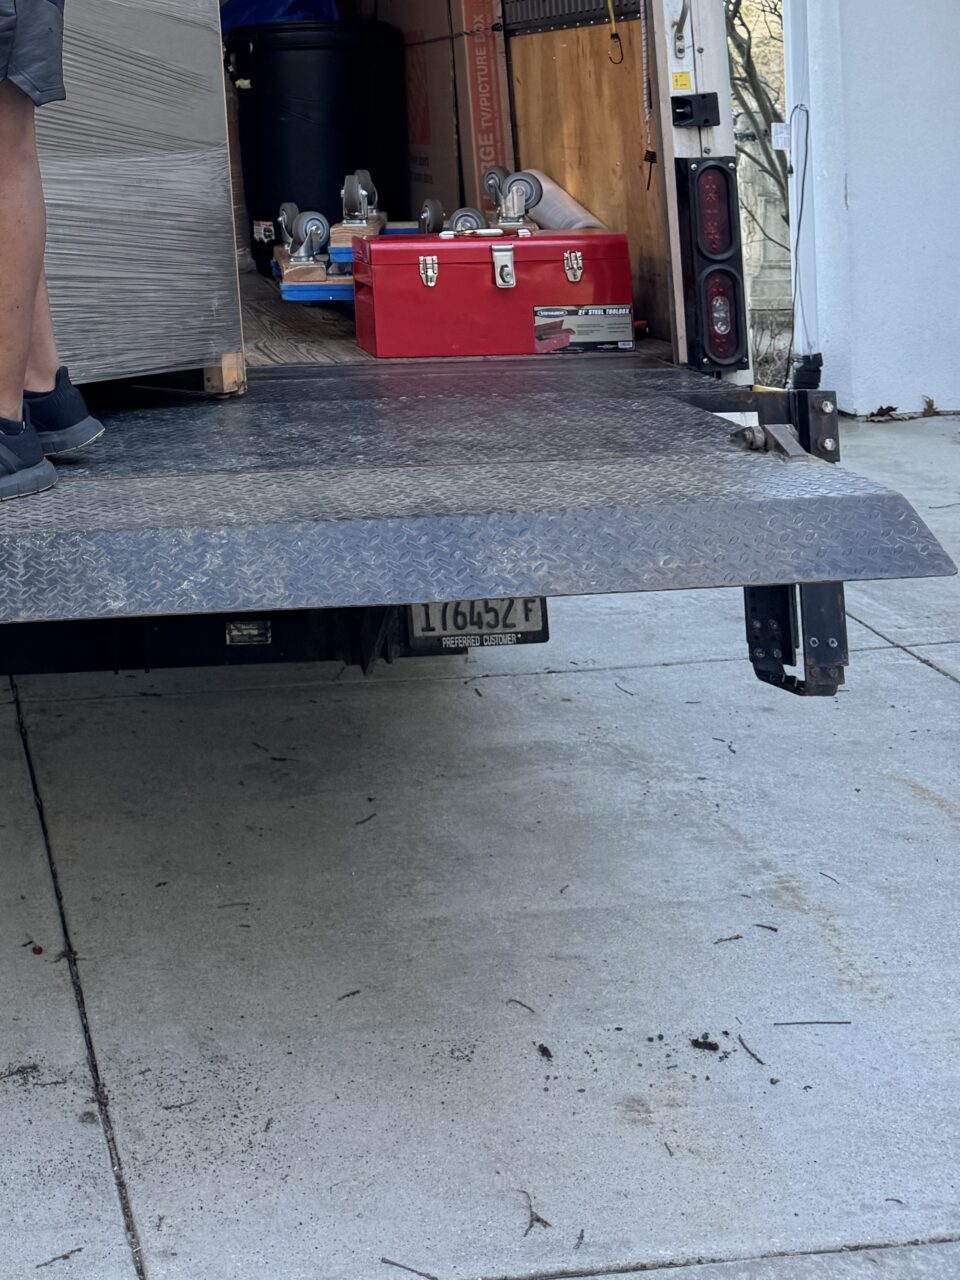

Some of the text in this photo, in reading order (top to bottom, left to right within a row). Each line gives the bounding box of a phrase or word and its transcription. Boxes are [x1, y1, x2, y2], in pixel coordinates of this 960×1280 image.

[473, 14, 487, 44] BOX
[476, 46, 493, 129] TV/PICTURE
[442, 633, 517, 648] PREFERRED CUSTOMER
